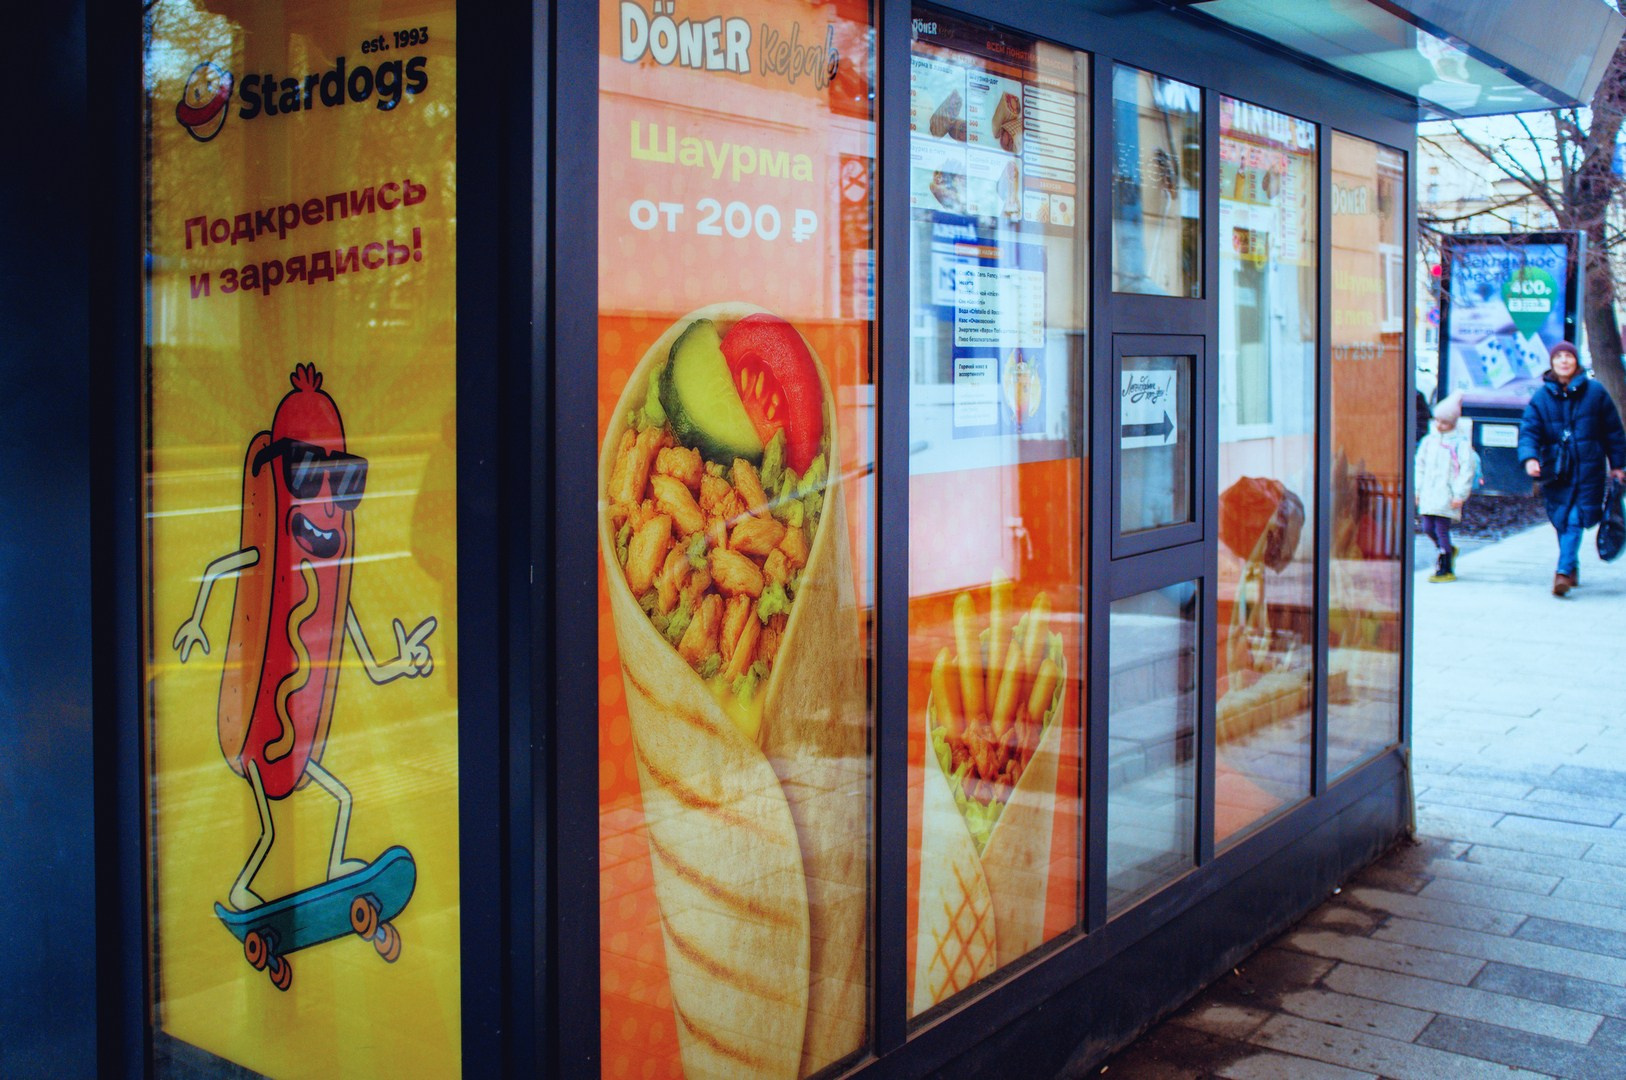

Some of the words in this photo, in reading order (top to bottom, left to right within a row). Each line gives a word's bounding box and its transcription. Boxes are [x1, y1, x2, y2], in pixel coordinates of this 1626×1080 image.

[361, 35, 389, 54] est.
[393, 26, 429, 49] 1993
[620, 0, 751, 75] DÖNER
[759, 22, 839, 90] Kebab
[239, 55, 428, 120] Stardogs
[630, 120, 813, 182] Шаурма
[184, 179, 427, 250] Подкрепись
[629, 199, 684, 233] от
[696, 197, 782, 241] 200
[791, 208, 818, 243] ₽
[189, 272, 211, 299] и
[220, 227, 423, 296] зарядись!
